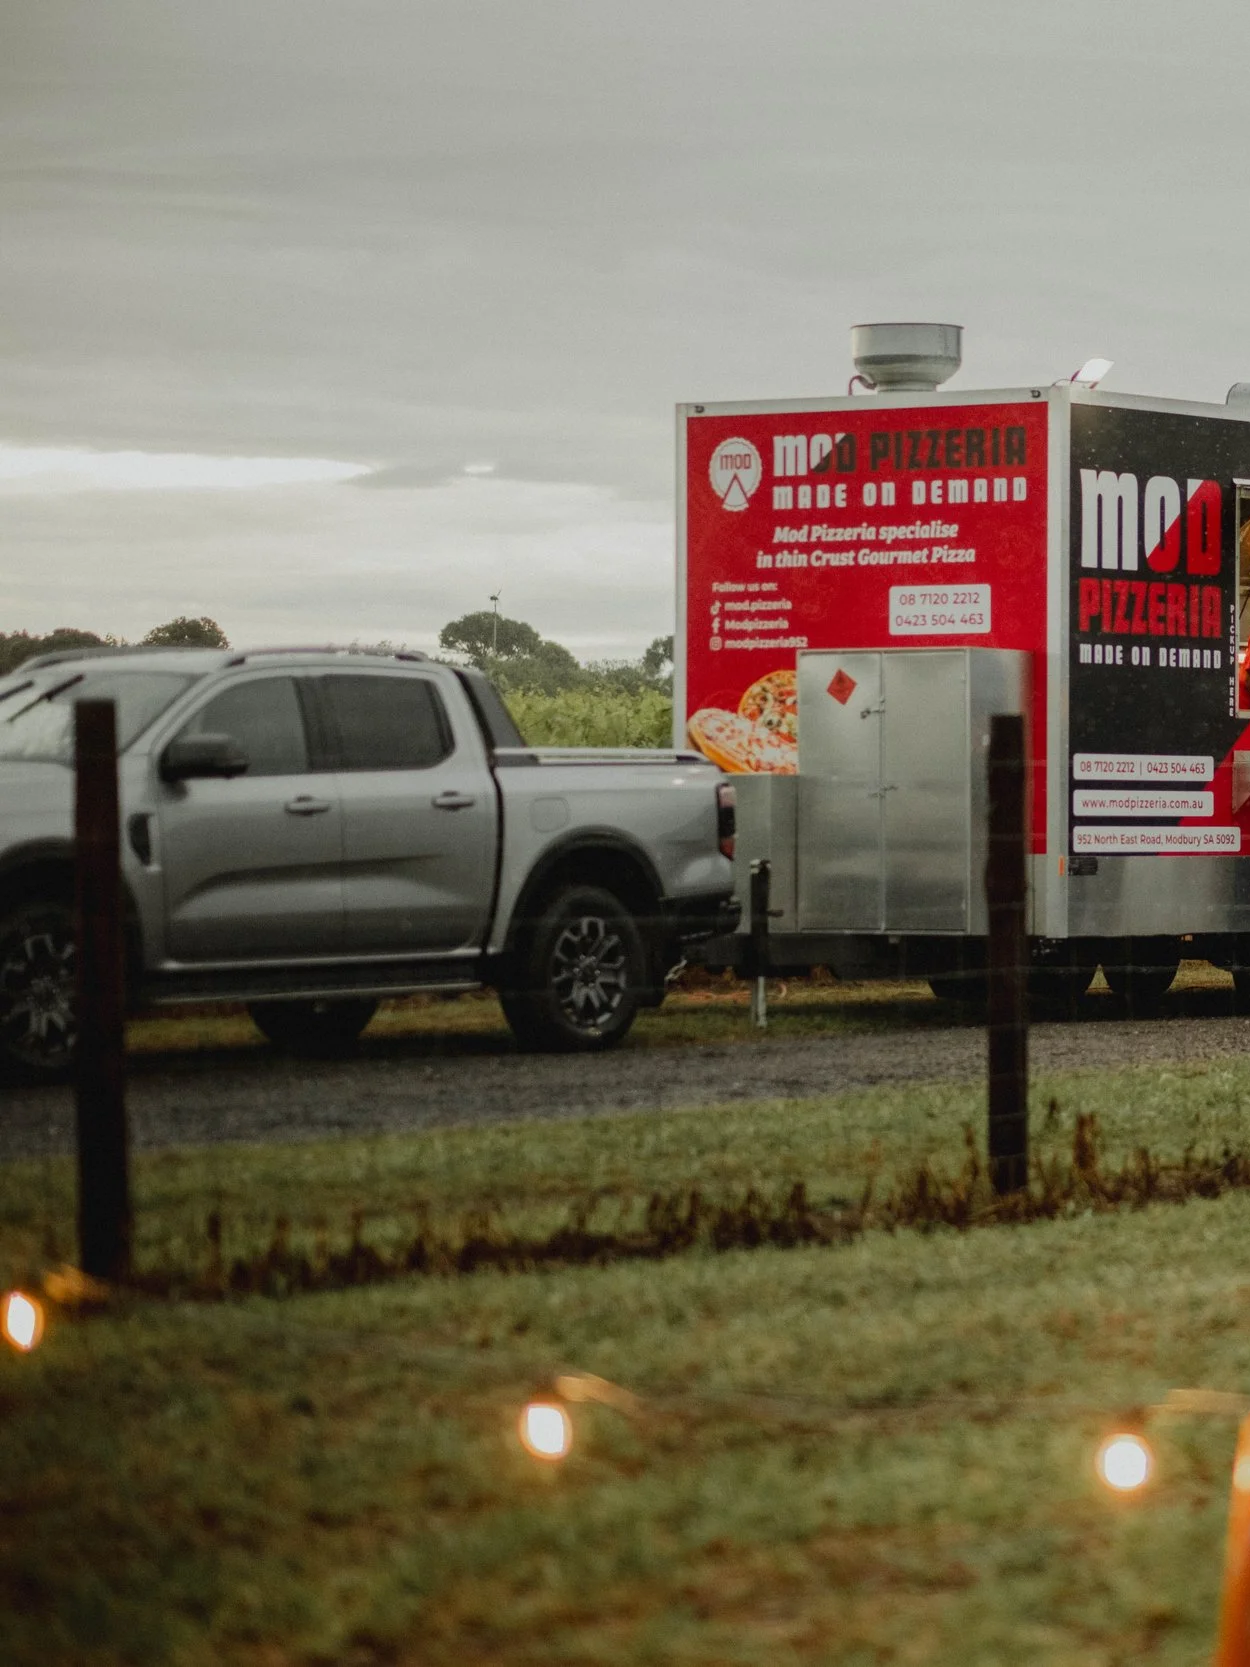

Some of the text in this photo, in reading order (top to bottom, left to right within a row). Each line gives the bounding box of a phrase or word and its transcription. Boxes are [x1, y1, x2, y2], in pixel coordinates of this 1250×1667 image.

[870, 426, 1027, 471] PIZZERIA
[772, 520, 959, 544] Mod Pizzeria specialise
[756, 545, 976, 568] in thin Crust Gourmet Pizza
[899, 591, 981, 606] 08 7120 2212
[1079, 576, 1222, 638] PIZZERIA
[895, 612, 985, 627] 0423 504 463
[1080, 760, 1206, 775] 08 7120 2212 0423 504 463
[1082, 796, 1204, 811] www.modpizzeria.com.au
[1077, 834, 1092, 845] 952
[1094, 833, 1119, 845] North
[1120, 834, 1138, 845] East
[1165, 833, 1202, 848] Modbury
[1203, 834, 1215, 845] SA
[1216, 834, 1236, 845] 5092
